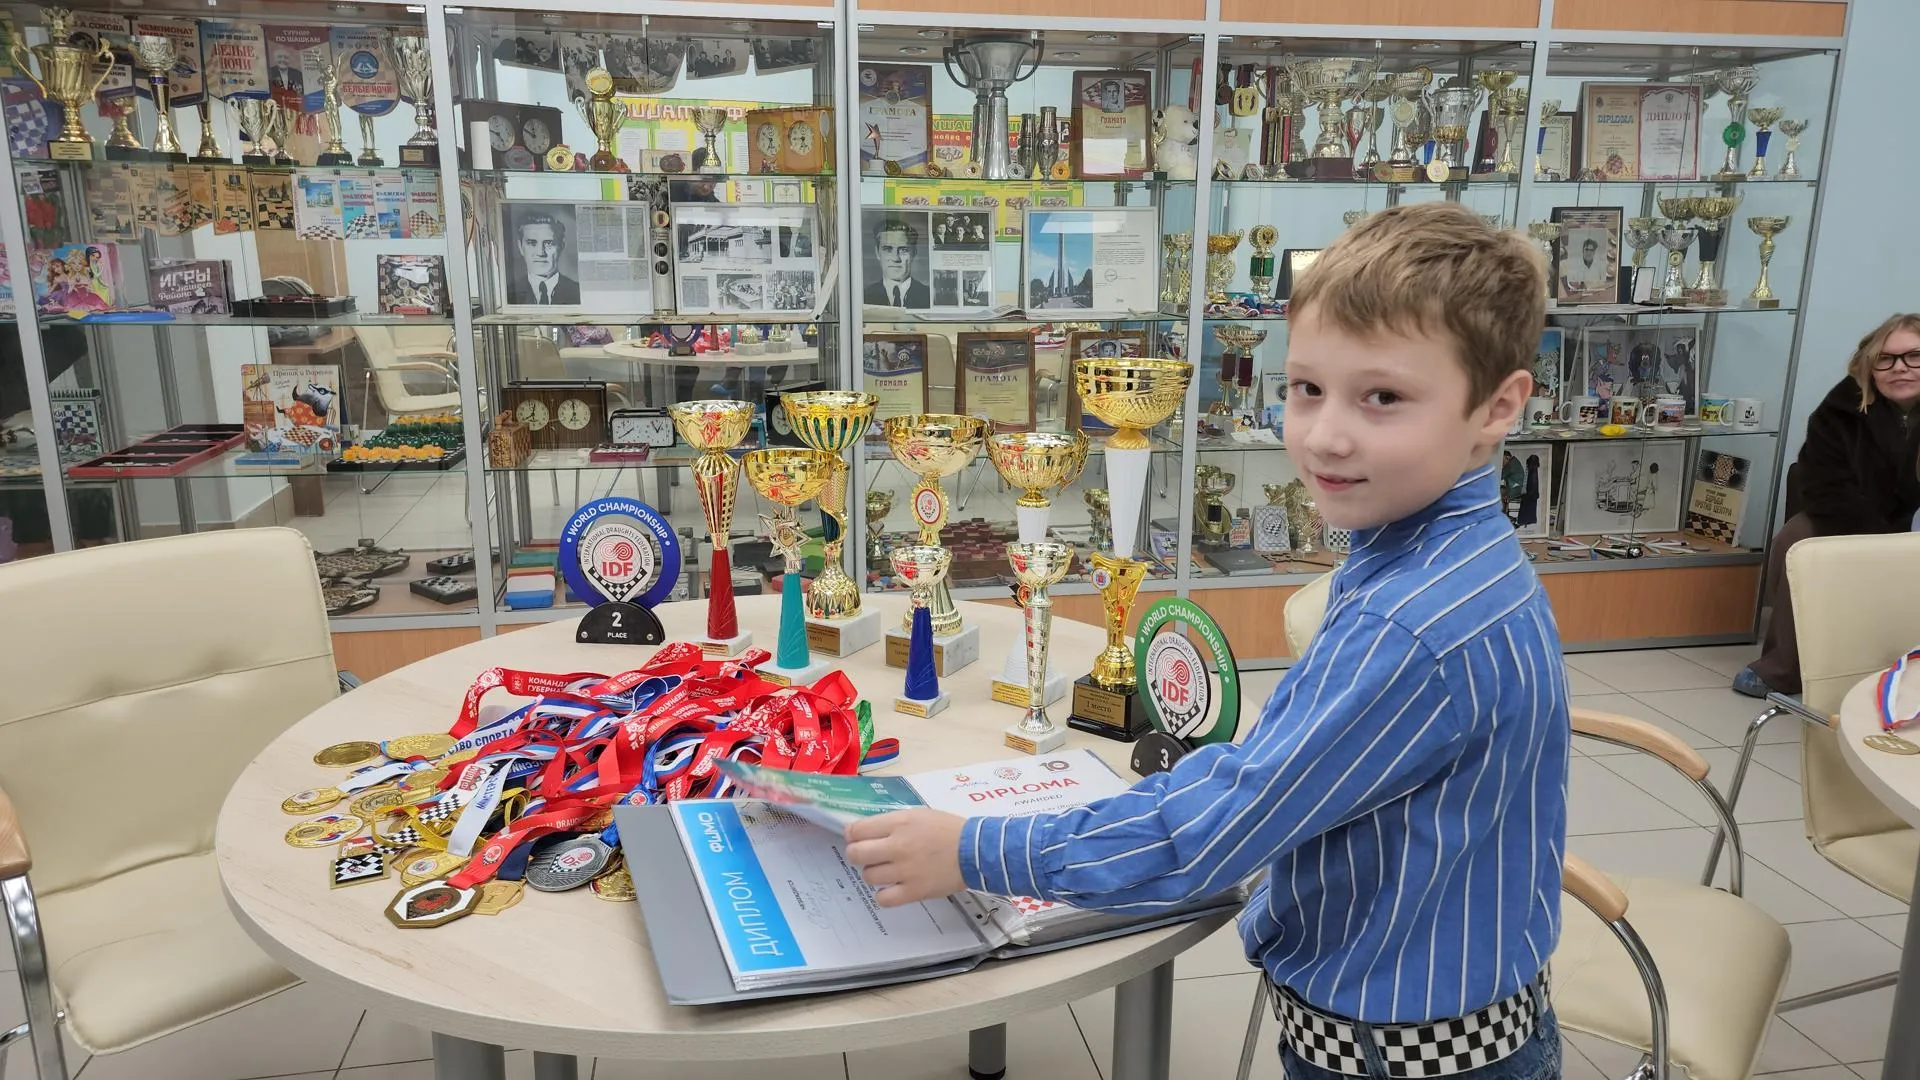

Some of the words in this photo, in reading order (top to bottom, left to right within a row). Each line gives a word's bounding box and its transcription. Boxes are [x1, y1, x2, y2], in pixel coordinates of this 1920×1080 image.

[160, 267, 211, 288] ИГРЫ
[974, 375, 1018, 383] ГРАМОТА
[568, 507, 597, 536] WORLD
[598, 502, 669, 539] CHAMPIONSHIP
[602, 562, 633, 577] IDF
[611, 612, 622, 628] 2
[1142, 606, 1168, 636] WORLD
[1168, 605, 1229, 674] CHAMPIONSHIP
[1162, 678, 1189, 707] IDF
[475, 728, 515, 747] СПОРТА
[1160, 749, 1169, 769] 3
[968, 777, 1079, 802] DIPLOMA
[1014, 794, 1063, 806] AWARDED
[561, 855, 580, 867] IDF
[721, 871, 784, 956] ДИПЛОМ
